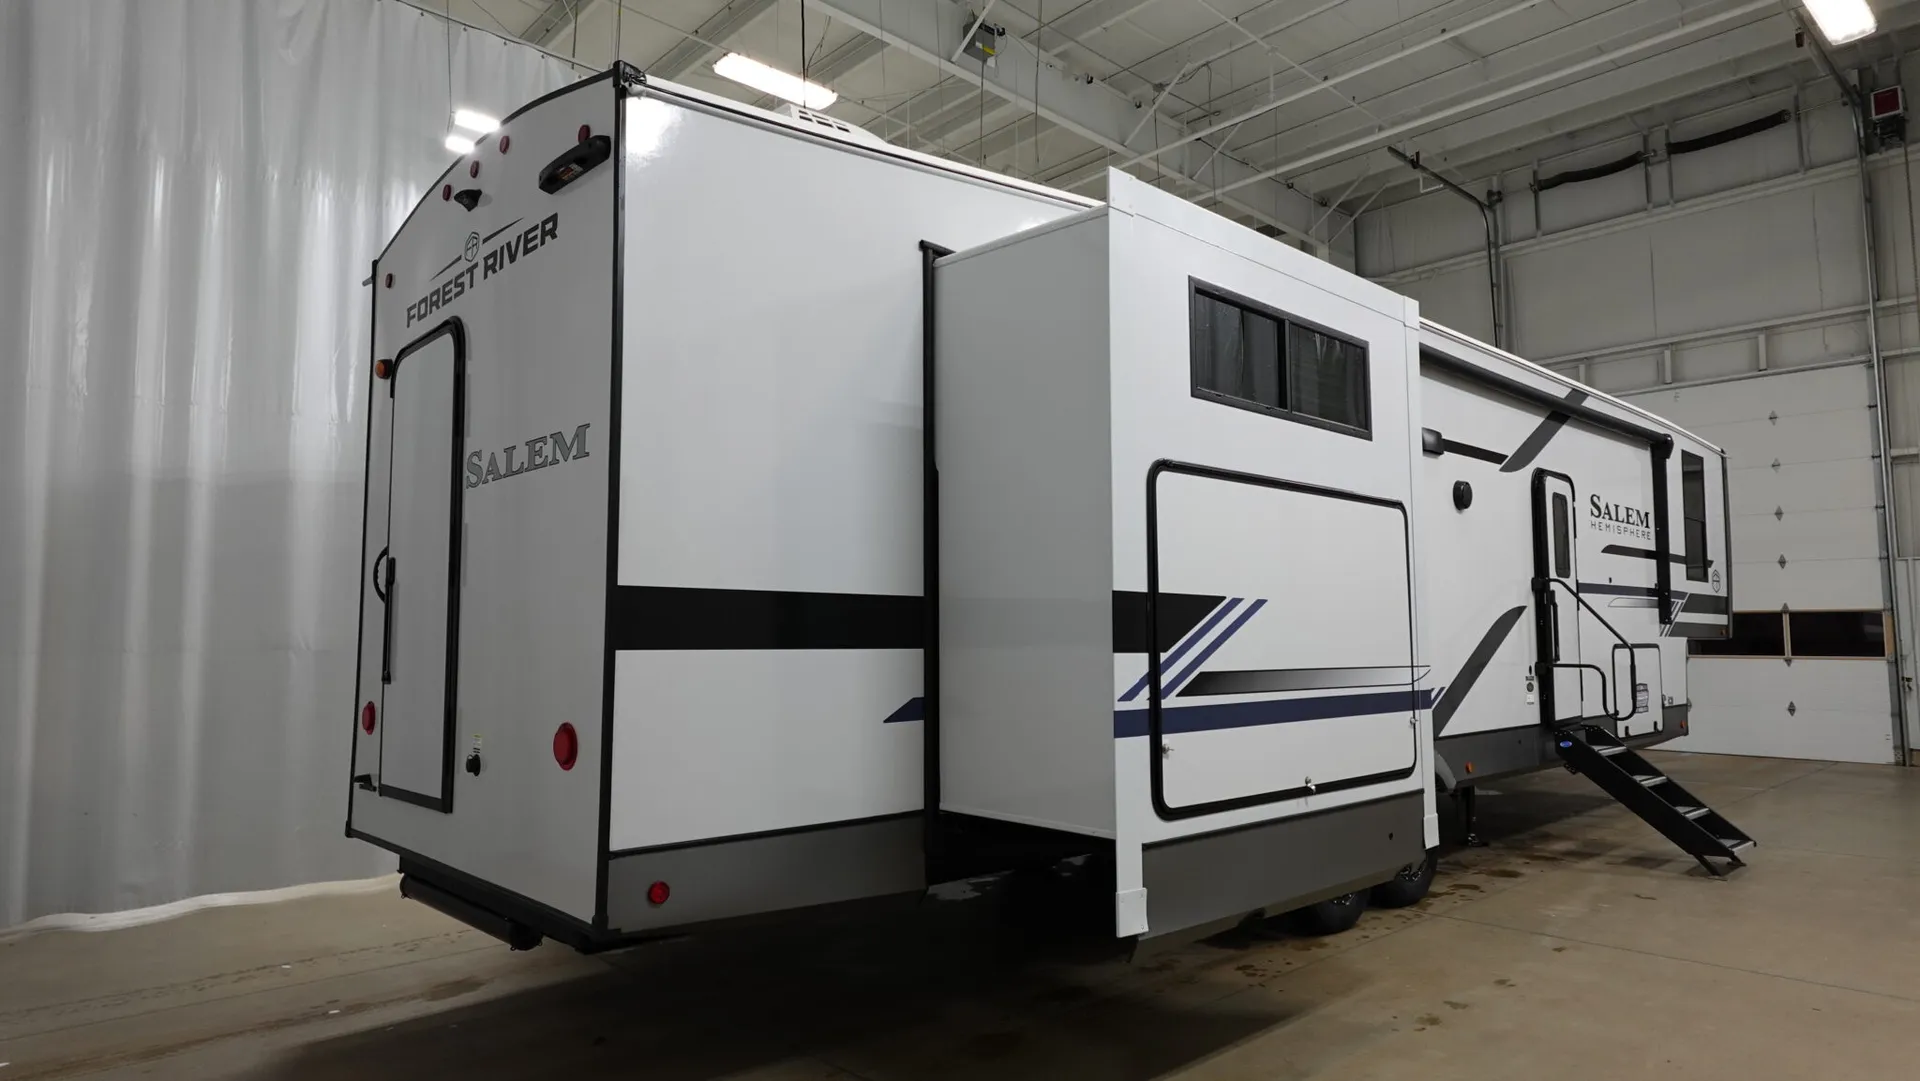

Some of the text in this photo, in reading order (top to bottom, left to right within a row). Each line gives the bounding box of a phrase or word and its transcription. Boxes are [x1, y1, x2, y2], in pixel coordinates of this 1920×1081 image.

[406, 212, 559, 329] FOREST RIVER
[465, 422, 591, 490] SALEM
[1590, 493, 1651, 529] SALEM
[1590, 520, 1652, 541] HEMISPHERE
